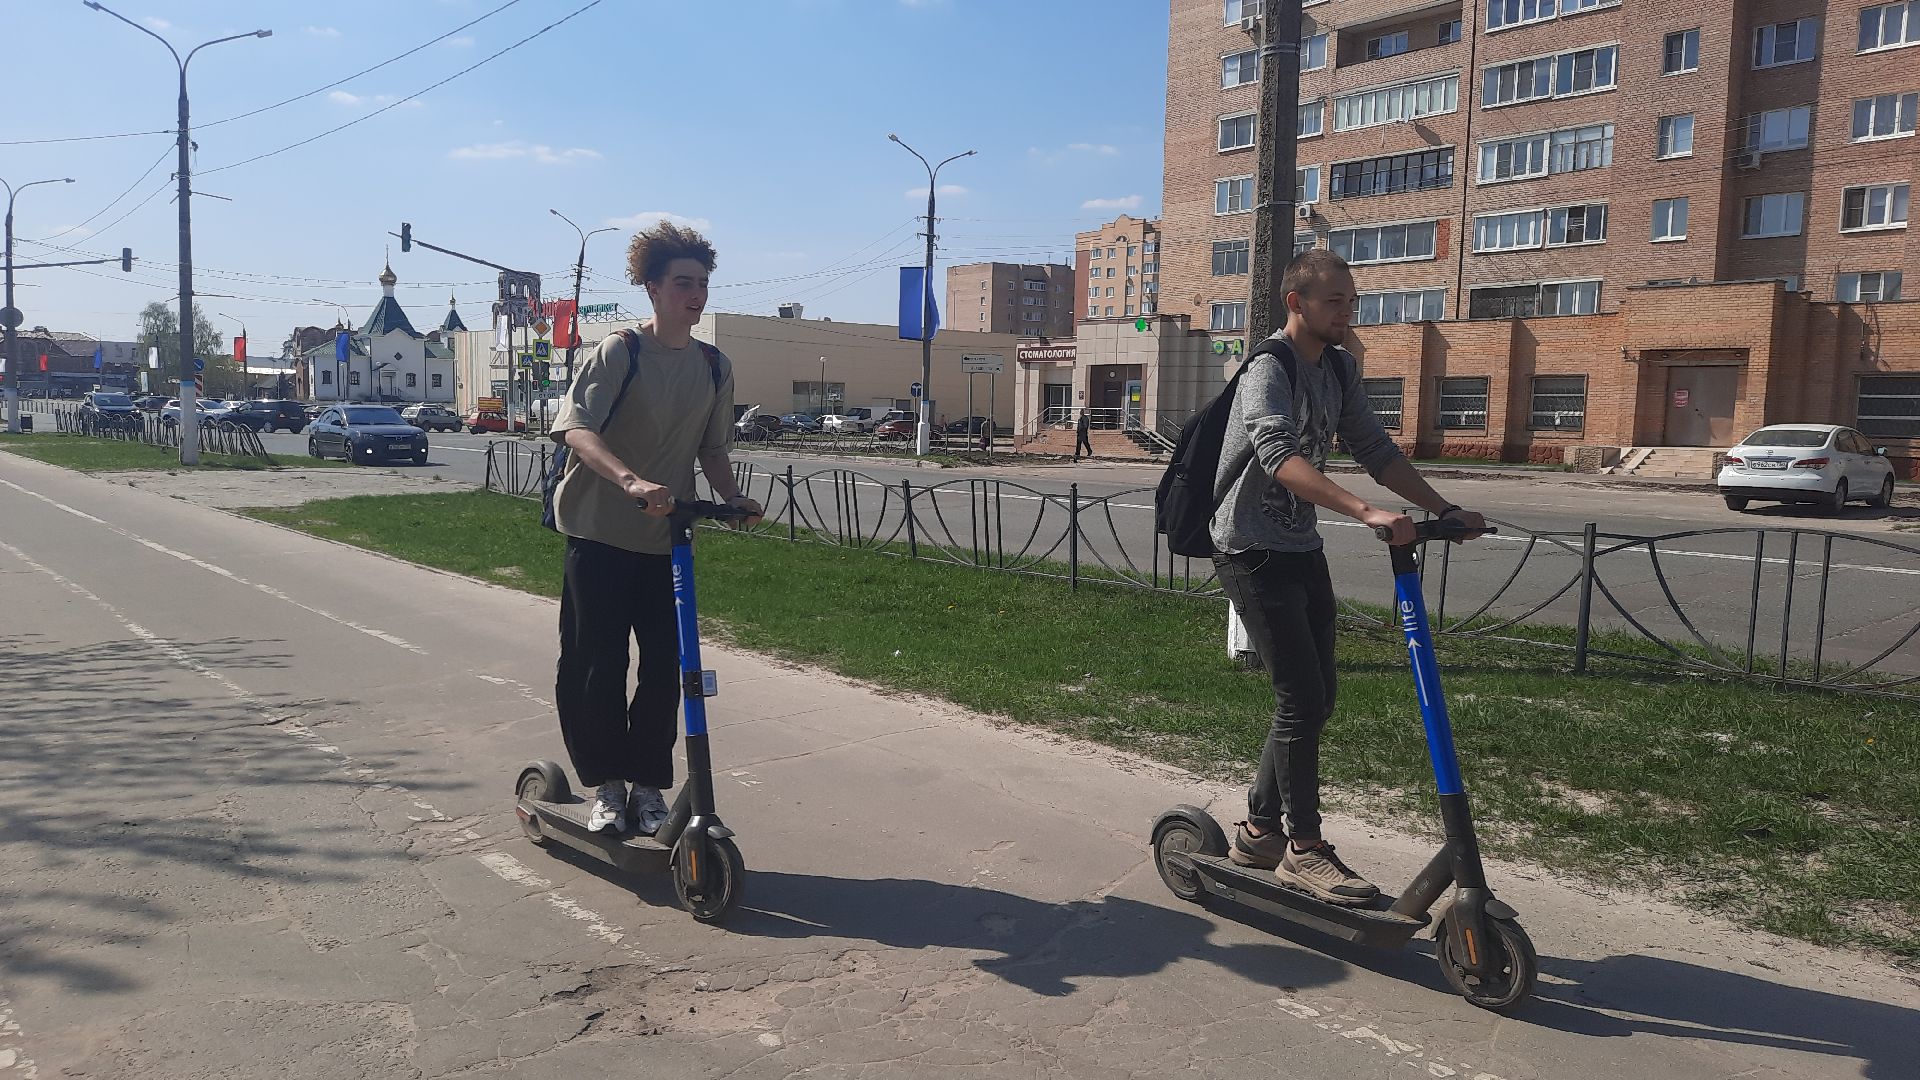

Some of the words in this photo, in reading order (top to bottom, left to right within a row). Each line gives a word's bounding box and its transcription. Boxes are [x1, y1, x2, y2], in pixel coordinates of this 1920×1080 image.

[1019, 349, 1076, 359] СТОМАТОЛОГИЯ
[672, 564, 683, 592] lite
[1401, 600, 1418, 632] lite
